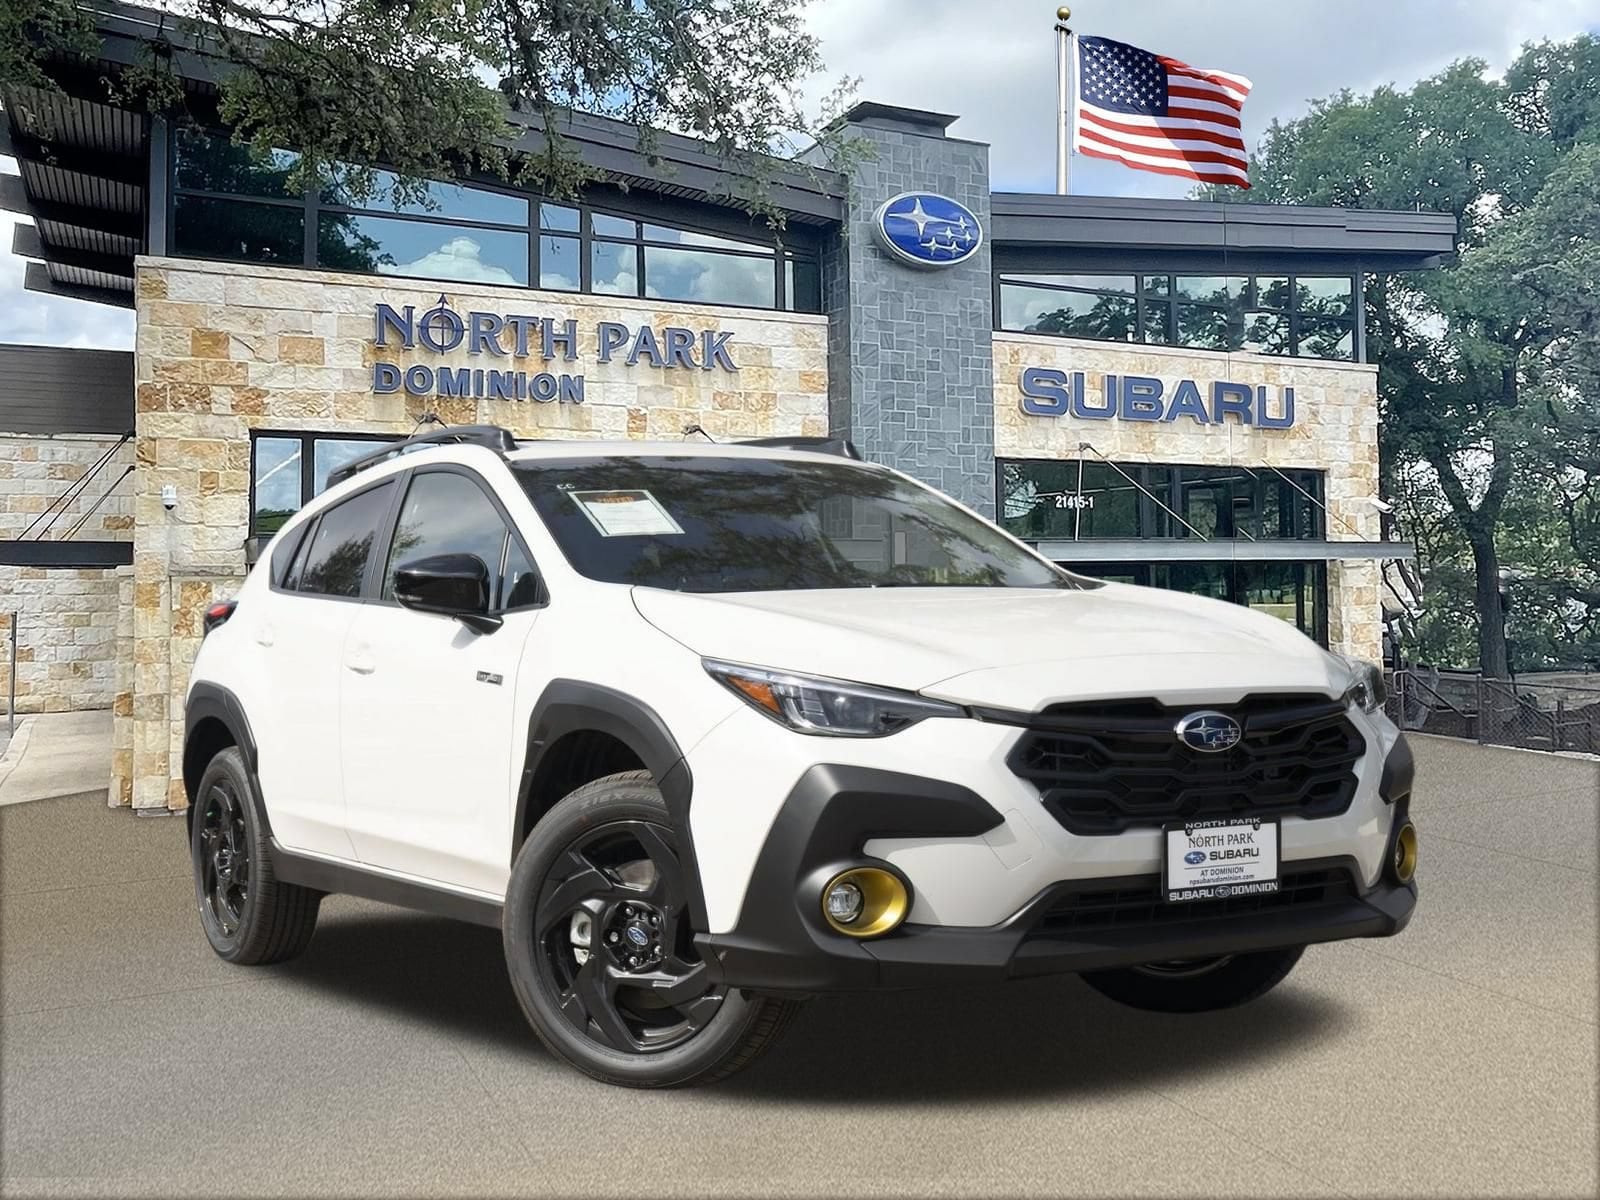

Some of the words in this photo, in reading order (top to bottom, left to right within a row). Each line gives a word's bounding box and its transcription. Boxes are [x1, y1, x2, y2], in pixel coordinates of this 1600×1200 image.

[375, 294, 579, 361] NORTH
[597, 321, 740, 372] PARK
[373, 362, 585, 404] DOMINION
[1019, 366, 1295, 430] SUBARU
[1185, 820, 1226, 829] NORTH
[1230, 818, 1261, 826] PARK
[1188, 834, 1225, 848] NORTH
[1227, 833, 1255, 845] PARK
[1209, 847, 1259, 861] SUBARU
[1200, 869, 1210, 877] AT
[1210, 866, 1245, 876] DOMINION
[1169, 888, 1214, 901] SUBARU
[1231, 882, 1278, 896] DOMINION
